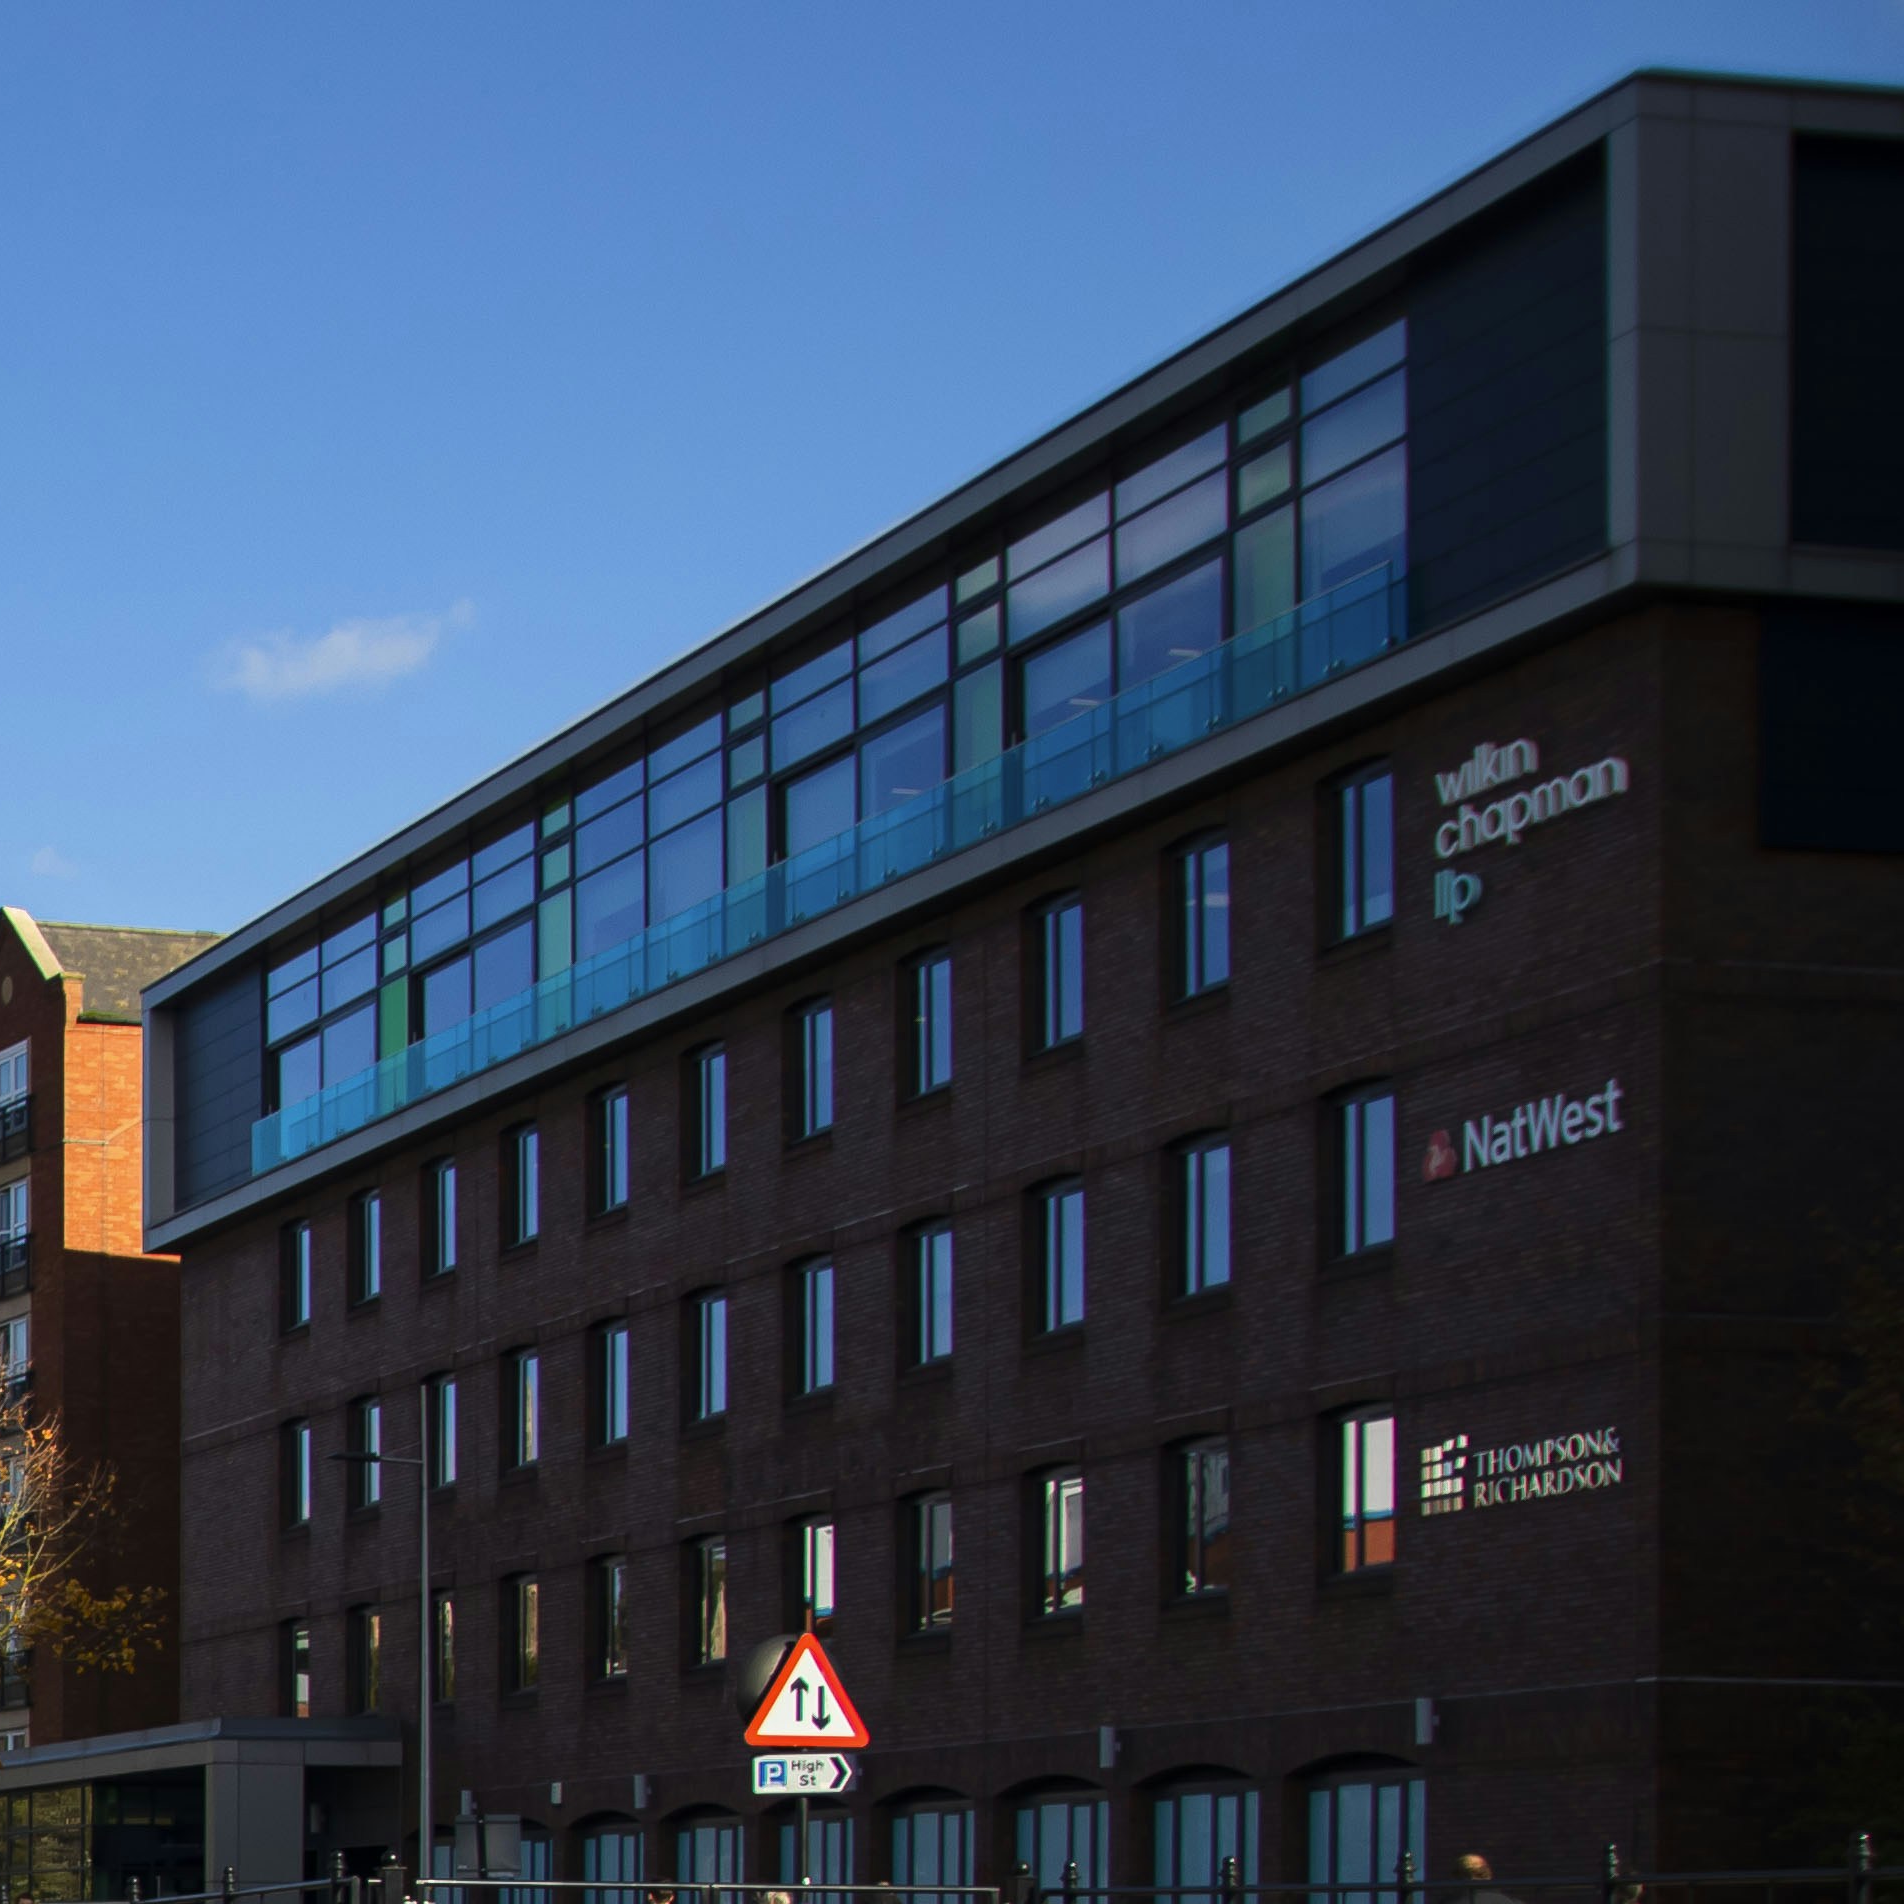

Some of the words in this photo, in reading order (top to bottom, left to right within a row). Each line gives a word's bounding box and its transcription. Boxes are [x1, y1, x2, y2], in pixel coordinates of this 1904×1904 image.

[1435, 739, 1539, 806] wilkin
[1435, 757, 1630, 859] chapman
[1434, 868, 1483, 924] llp
[1463, 1078, 1623, 1173] NatWest
[1474, 1458, 1623, 1509] RICHARDSON
[791, 1760, 824, 1773] High
[799, 1775, 816, 1786] St
